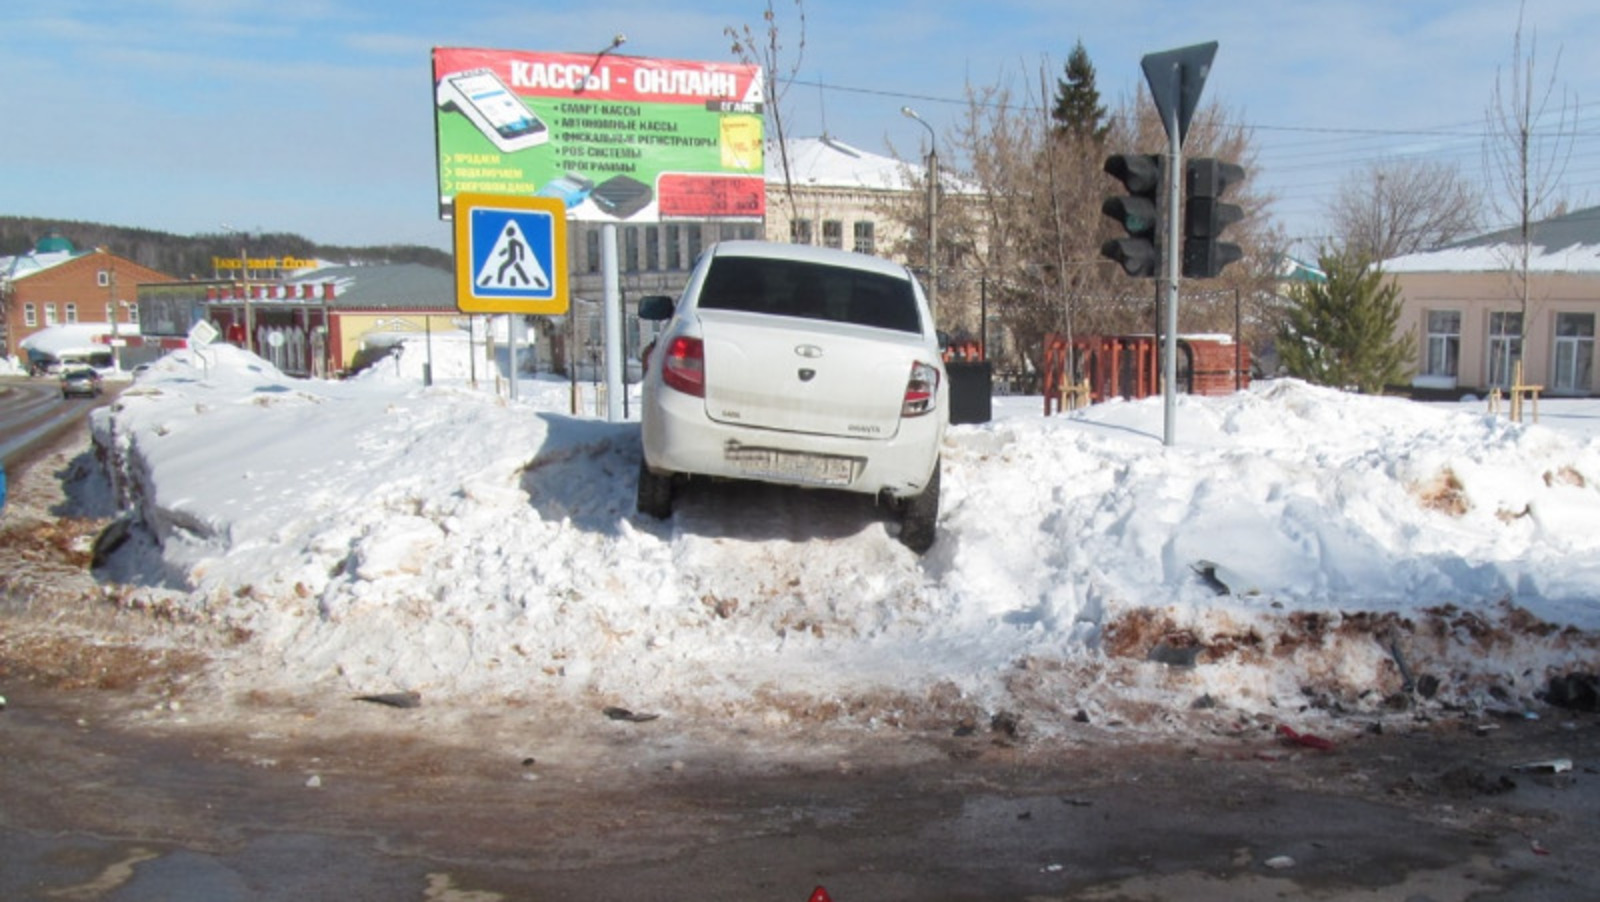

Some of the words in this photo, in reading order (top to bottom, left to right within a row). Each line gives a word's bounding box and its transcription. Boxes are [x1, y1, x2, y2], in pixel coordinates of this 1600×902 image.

[510, 60, 610, 91] КАССЫ
[633, 66, 737, 97] ОНЛАЙН
[561, 117, 636, 130] АВТОНОМНЫЕ
[639, 121, 678, 132] КАССЫ
[638, 134, 717, 147] РЕГИСТРАТОРЫ
[562, 159, 637, 173] ПРОГРАММЫ
